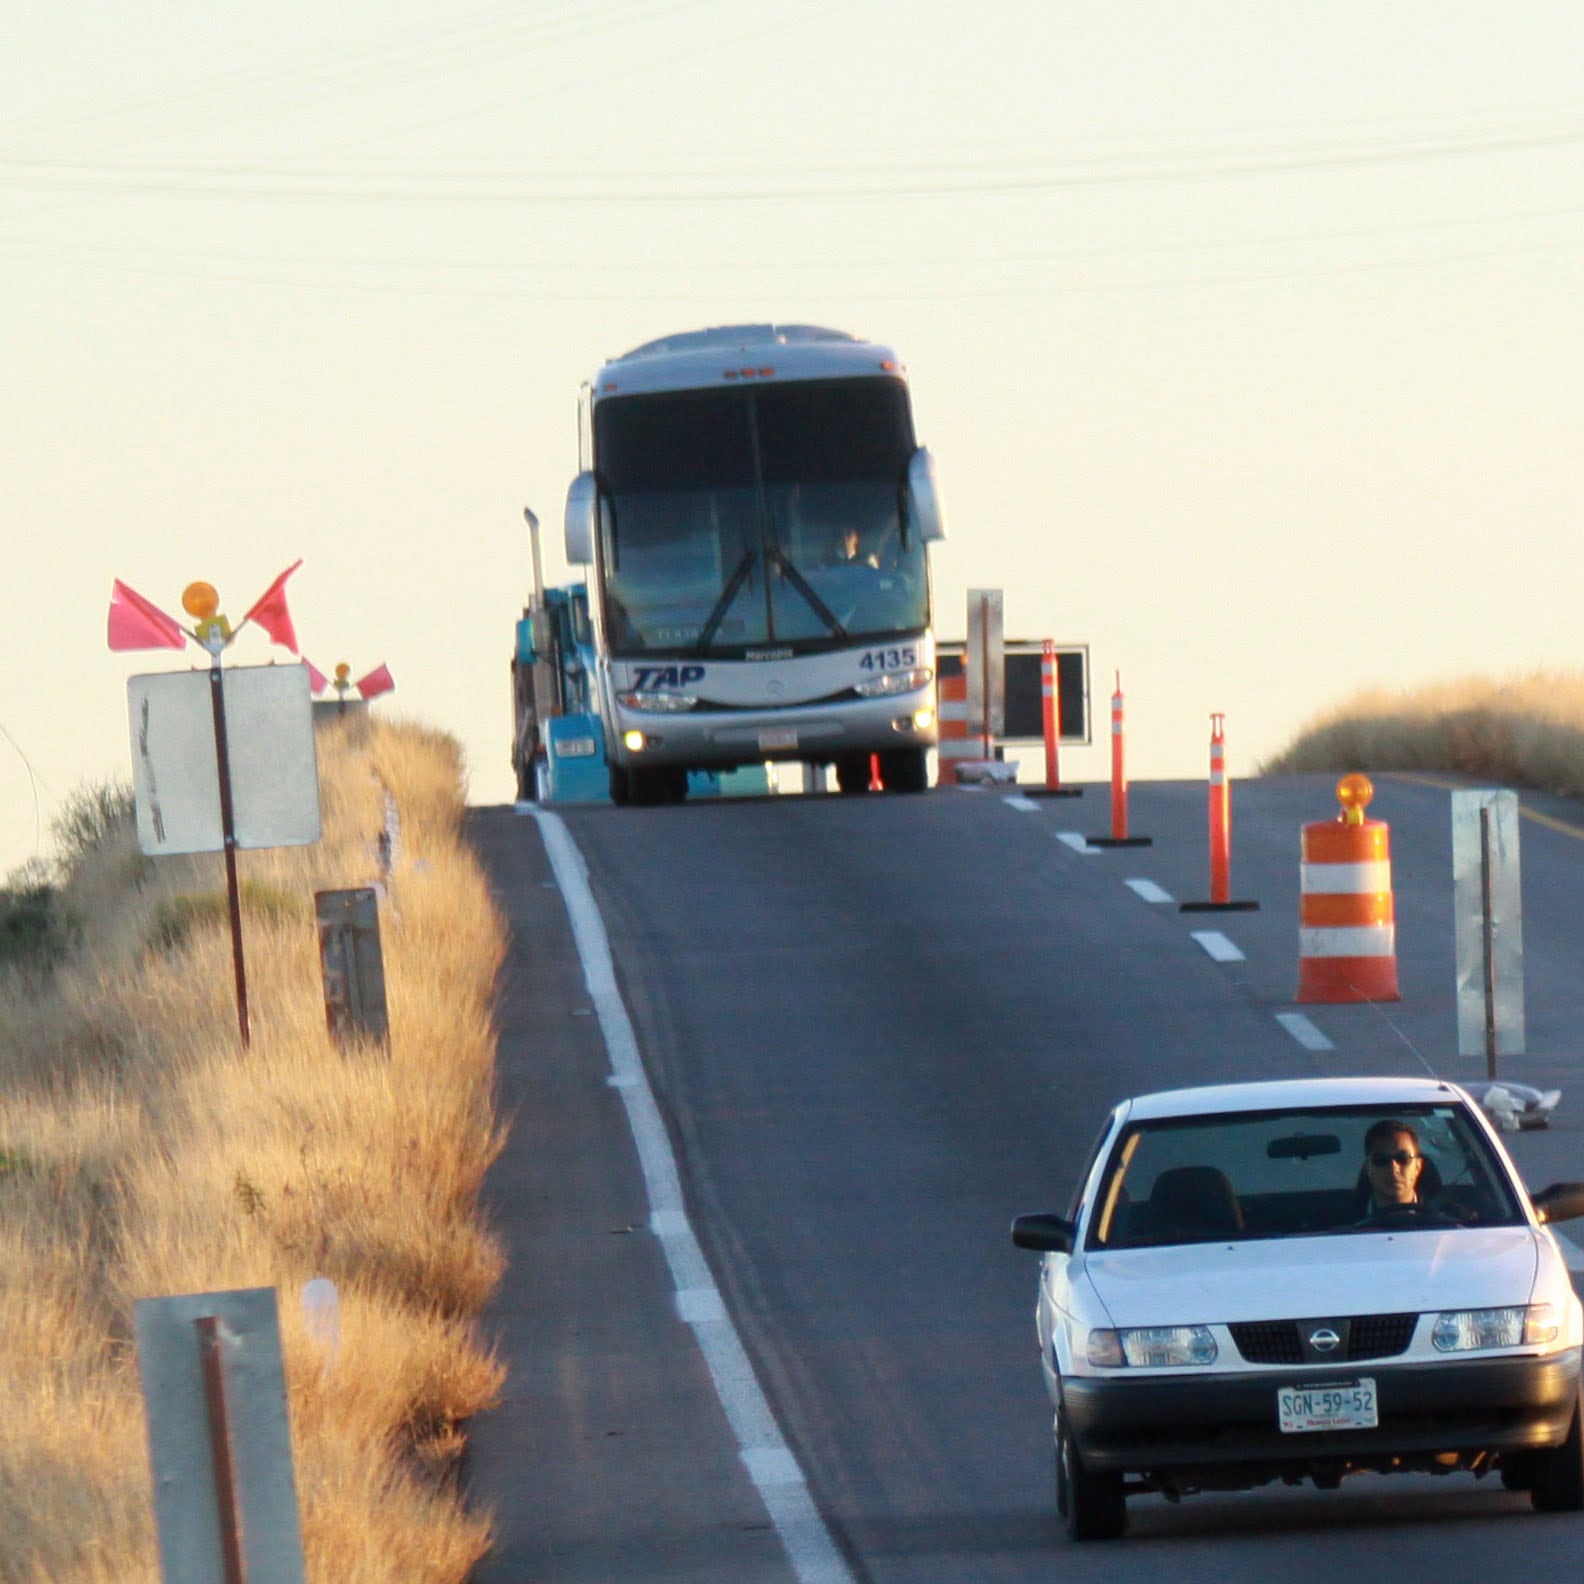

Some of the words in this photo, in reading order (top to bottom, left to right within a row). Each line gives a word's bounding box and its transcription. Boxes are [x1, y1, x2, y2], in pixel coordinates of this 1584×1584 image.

[860, 648, 915, 671] 4135
[632, 665, 706, 691] TAP
[1282, 1391, 1373, 1416] SGN-59-52
